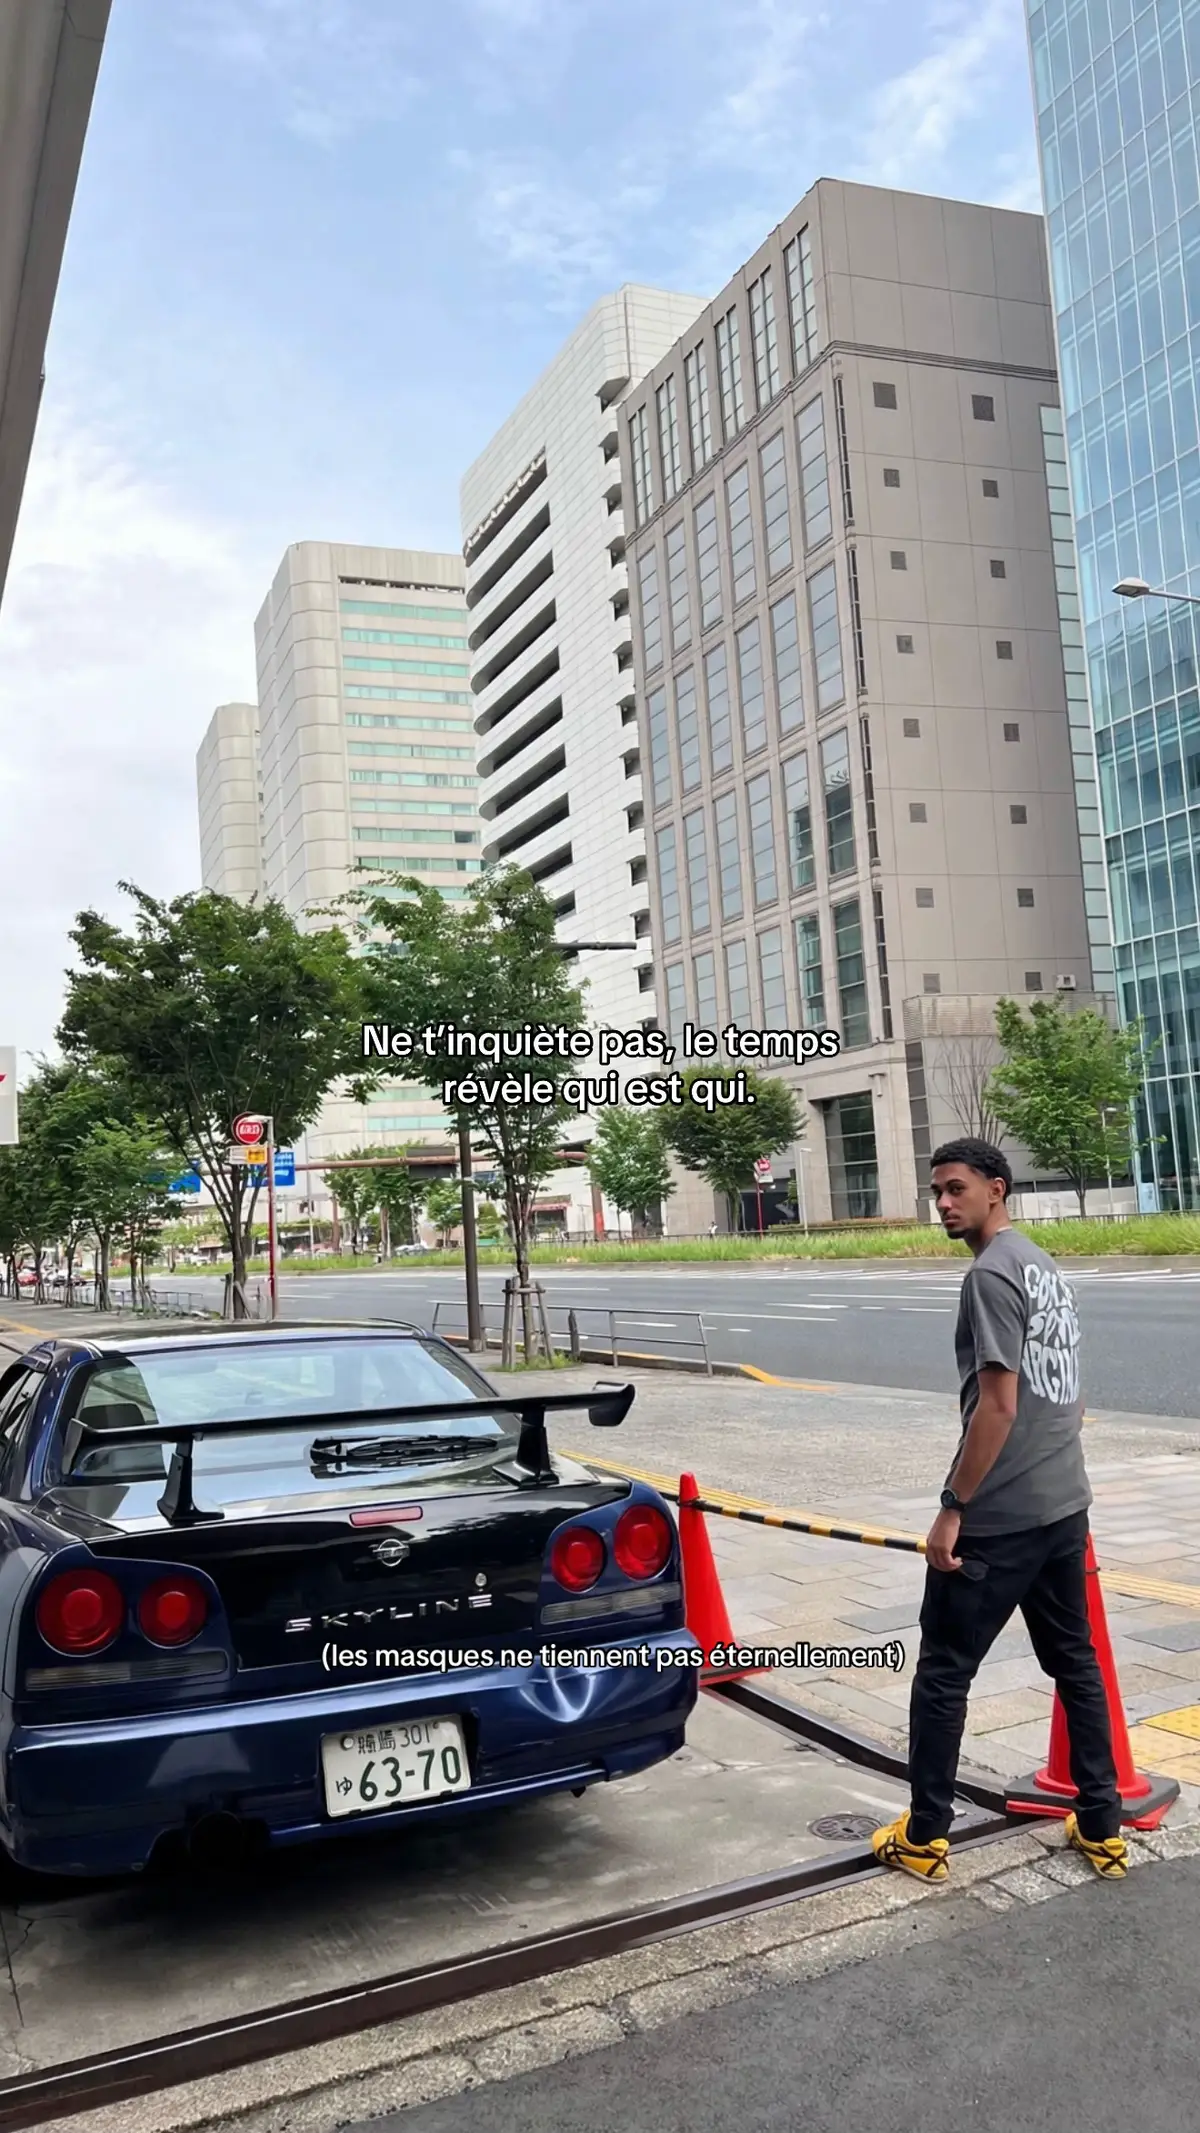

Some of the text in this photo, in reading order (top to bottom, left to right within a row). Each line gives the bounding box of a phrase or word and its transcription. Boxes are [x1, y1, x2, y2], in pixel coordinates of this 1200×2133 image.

[285, 1593, 493, 1633] SKYLINE
[399, 1723, 431, 1748] 301
[335, 1745, 462, 1802] ゆ 63-70
